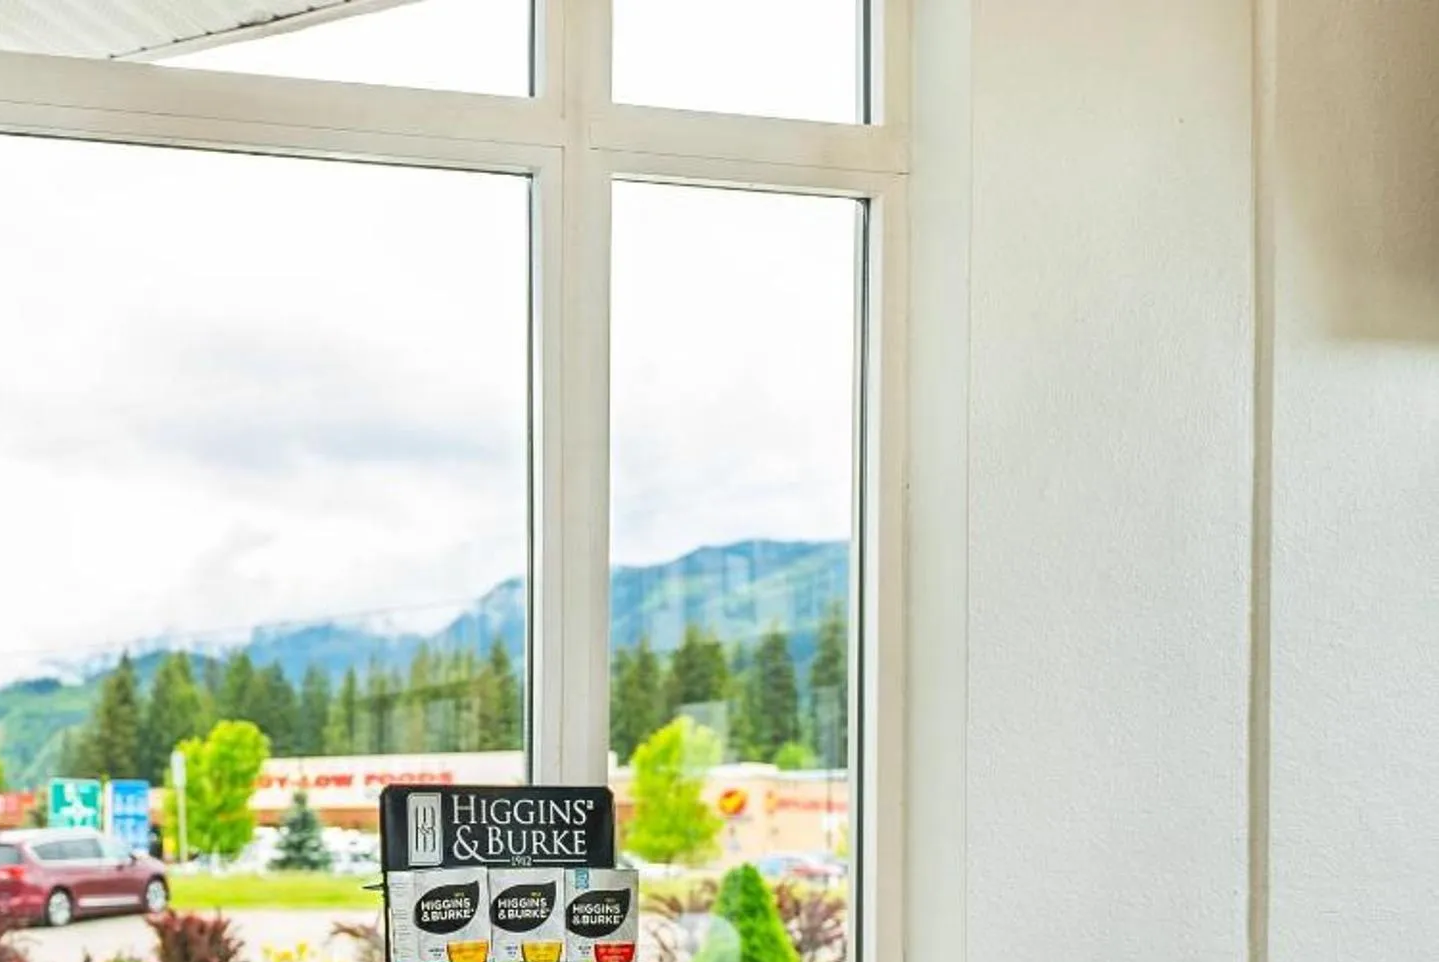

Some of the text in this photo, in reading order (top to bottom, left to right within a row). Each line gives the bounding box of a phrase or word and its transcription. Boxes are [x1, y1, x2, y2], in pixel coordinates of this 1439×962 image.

[452, 794, 588, 826] HIGGINS
[487, 826, 587, 856] BURKE
[421, 898, 471, 911] HIGGINS
[498, 897, 547, 909] HIGGINS
[572, 903, 621, 914] HIGGINS
